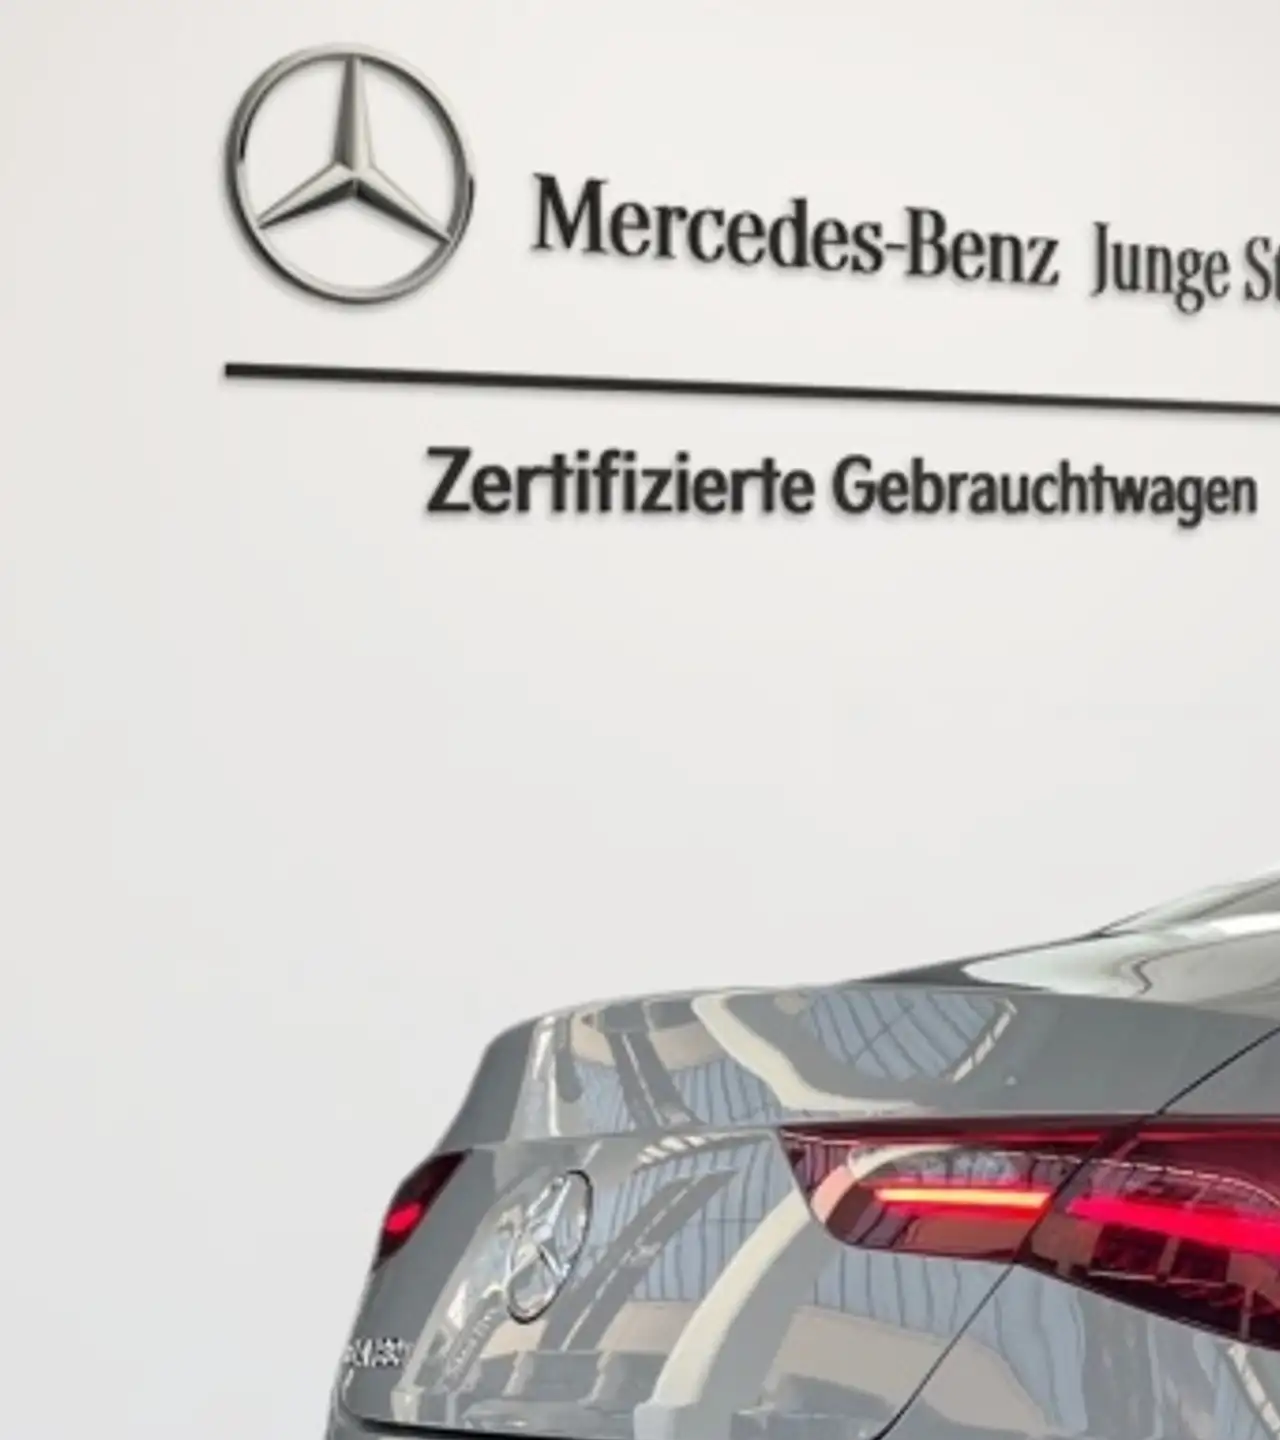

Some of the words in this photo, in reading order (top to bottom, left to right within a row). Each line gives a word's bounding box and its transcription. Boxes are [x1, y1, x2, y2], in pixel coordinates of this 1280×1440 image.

[534, 173, 1059, 287] Mercedes-Benz
[1091, 222, 1231, 314] Junge
[425, 446, 816, 516] Zertifizierte
[831, 454, 1258, 529] Gebrauchtwagen
